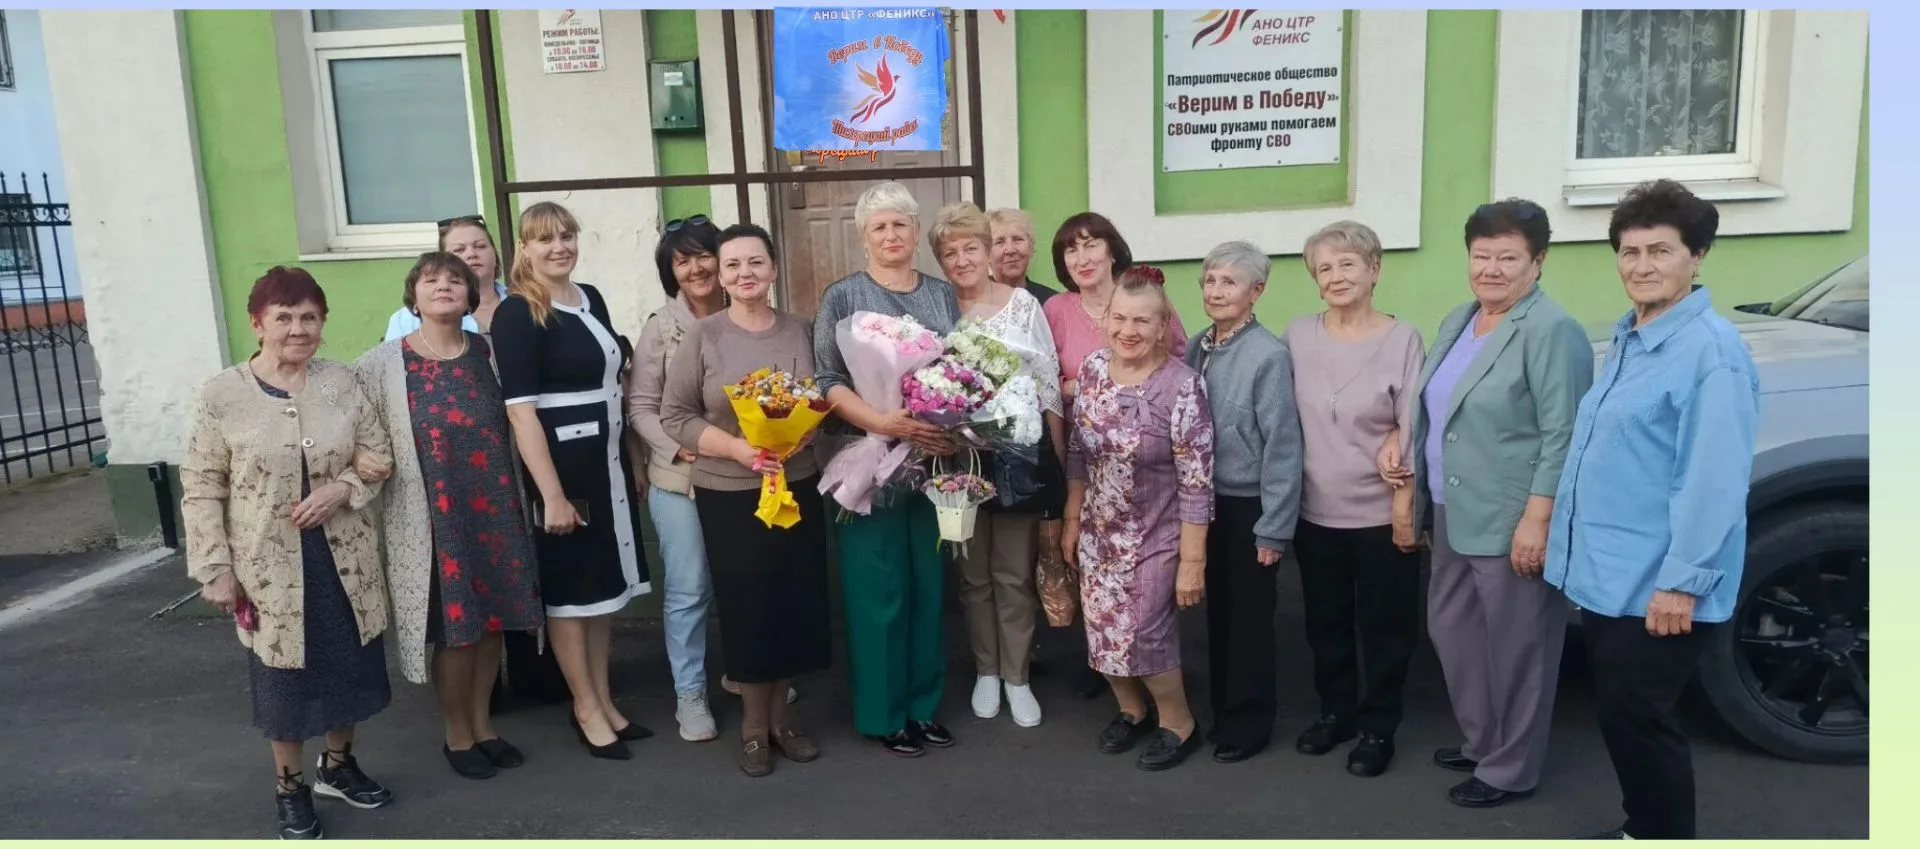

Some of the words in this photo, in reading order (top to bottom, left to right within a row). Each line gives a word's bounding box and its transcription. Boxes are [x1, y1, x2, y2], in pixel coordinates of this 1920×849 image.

[813, 10, 838, 21] АНО
[841, 10, 864, 20] ЦТР
[868, 8, 935, 19] «ФЕНИКС»
[1252, 18, 1283, 31] АНО
[1287, 16, 1315, 30] ЦТР
[542, 29, 568, 38] РЕЖИМ
[1252, 32, 1311, 46] ФЕНИКС
[827, 40, 868, 64] Верим
[873, 35, 881, 49] в
[884, 35, 924, 66] Победу
[1167, 69, 1271, 87] Патриотическое
[1275, 65, 1338, 81] общество
[1168, 95, 1238, 116] «Верим
[1243, 95, 1254, 110] в
[1259, 88, 1336, 110] Победу»
[1167, 122, 1217, 136] СВОими
[1220, 120, 1267, 135] руками
[1271, 116, 1337, 131] помогаем
[1211, 137, 1263, 153] фронту
[1266, 134, 1291, 147] СВО
